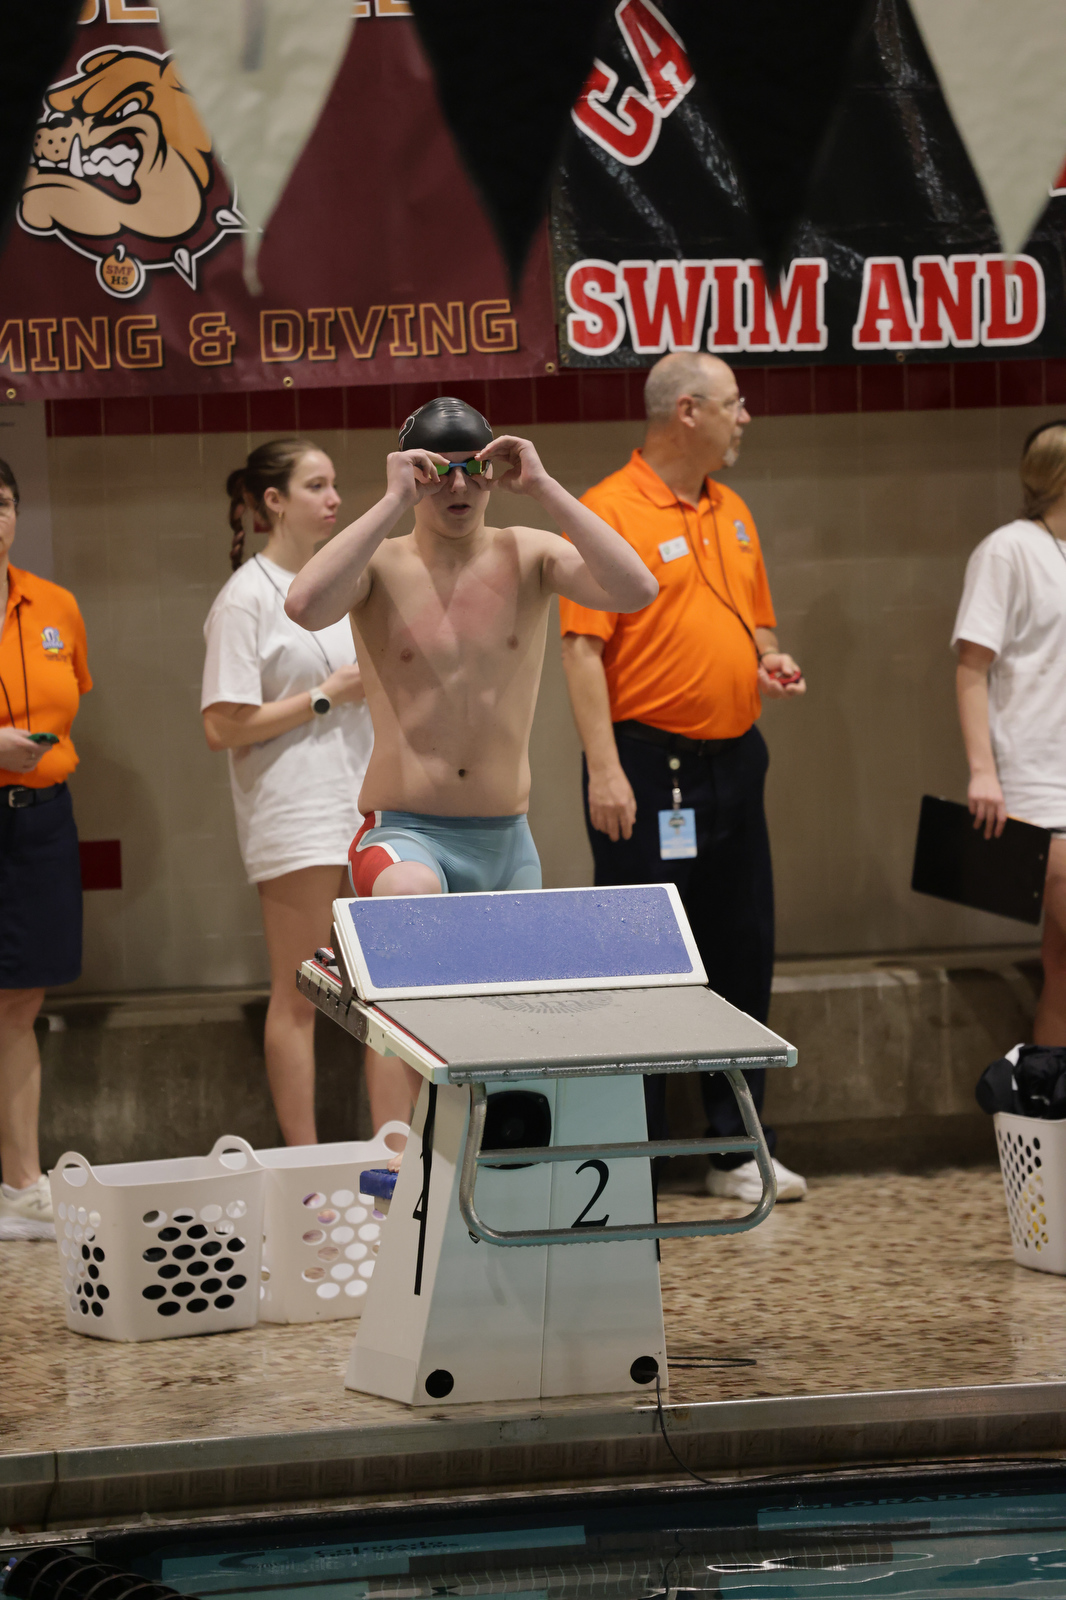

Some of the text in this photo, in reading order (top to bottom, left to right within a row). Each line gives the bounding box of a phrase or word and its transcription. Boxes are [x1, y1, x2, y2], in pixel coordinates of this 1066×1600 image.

[111, 275, 129, 286] HS
[564, 252, 1045, 355] SWIM AND
[188, 311, 237, 366] &
[259, 299, 518, 363] DIVING
[570, 1158, 610, 1229] 2
